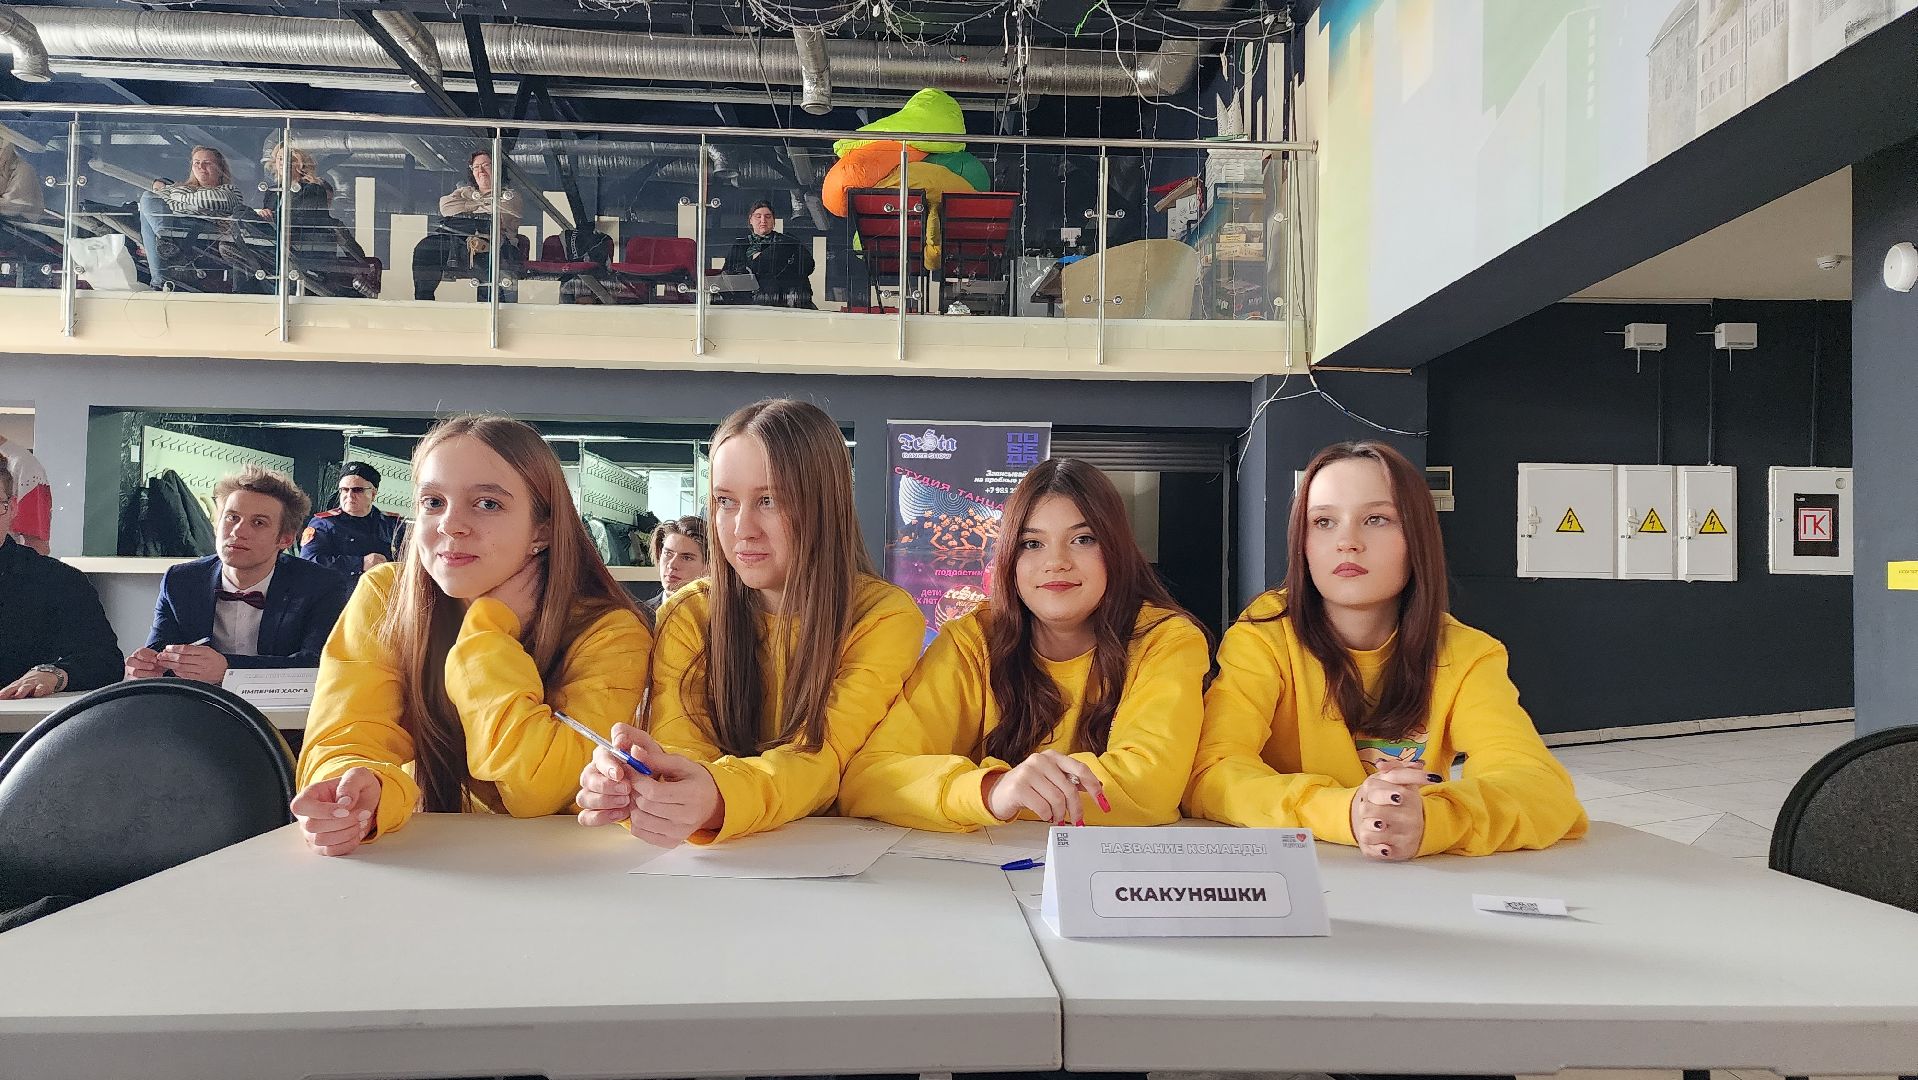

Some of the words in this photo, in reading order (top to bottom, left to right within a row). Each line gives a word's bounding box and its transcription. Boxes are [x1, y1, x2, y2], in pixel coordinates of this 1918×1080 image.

[894, 466, 950, 492] СТУДИЯ
[957, 488, 1005, 512] ТАНЦА
[1803, 514, 1827, 536] ПК
[921, 589, 941, 597] дети
[1100, 842, 1184, 854] НАЗВАНИЕ
[1187, 843, 1268, 856] КОМАНДЫ
[1115, 887, 1267, 902] СКАКУНЯШКИ
